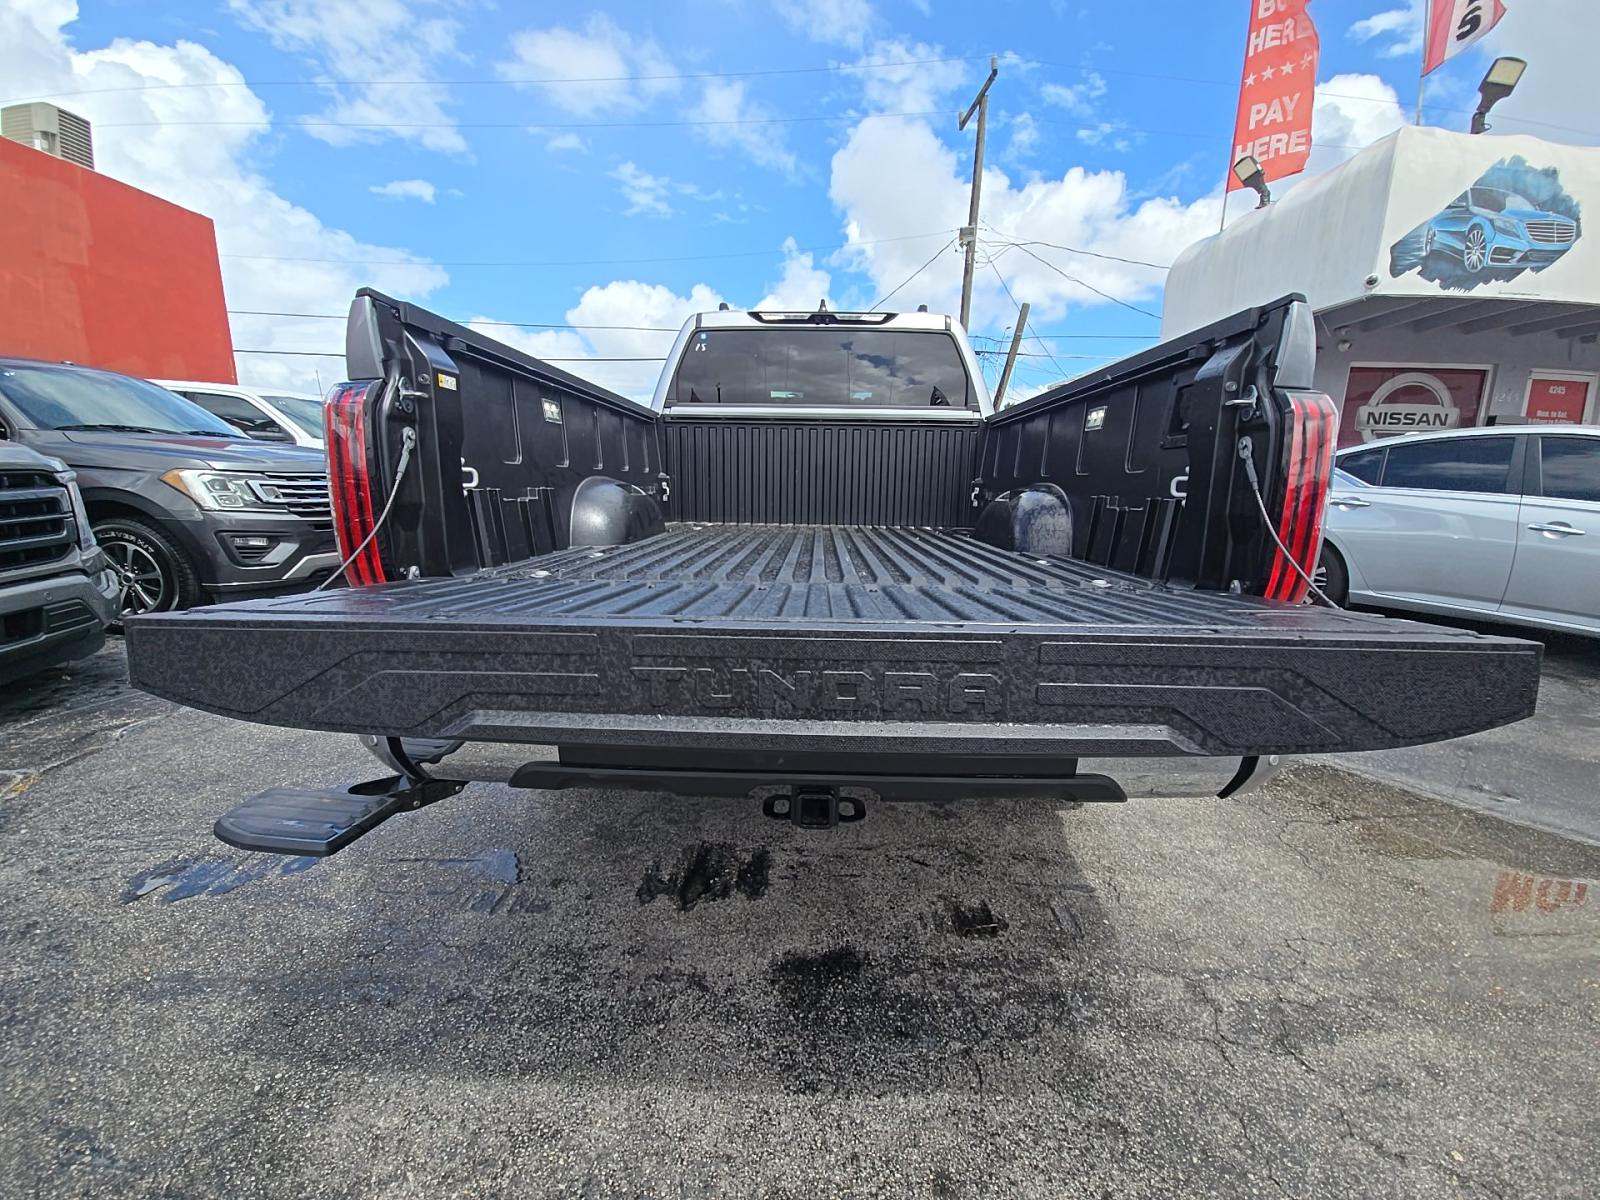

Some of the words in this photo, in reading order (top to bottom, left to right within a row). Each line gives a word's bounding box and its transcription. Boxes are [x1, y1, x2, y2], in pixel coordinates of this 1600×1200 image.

[1249, 93, 1300, 130] PAY
[1234, 129, 1308, 165] HERE
[1366, 411, 1449, 426] NISSAN
[630, 667, 1002, 714] TUNDRA
